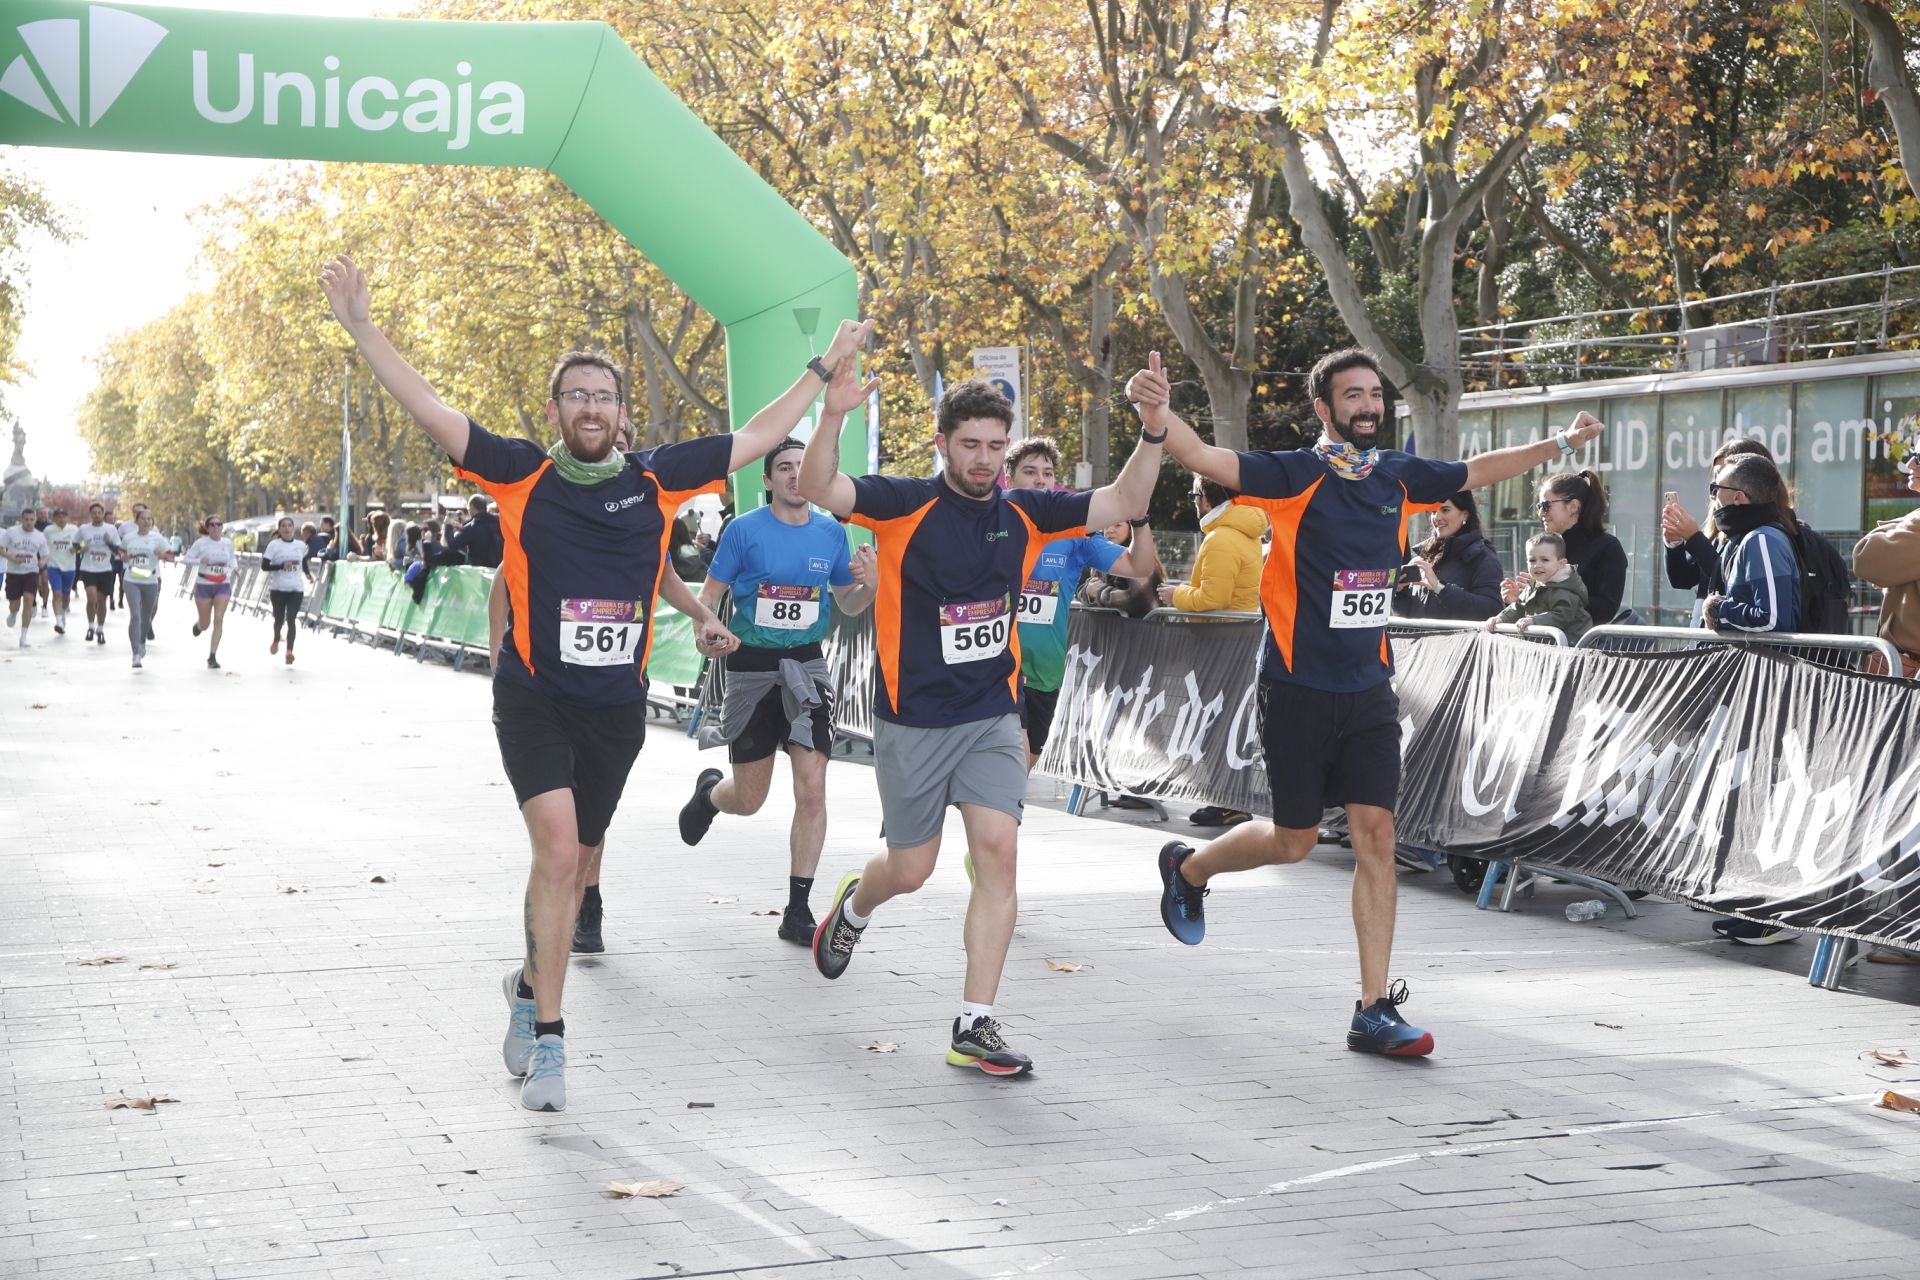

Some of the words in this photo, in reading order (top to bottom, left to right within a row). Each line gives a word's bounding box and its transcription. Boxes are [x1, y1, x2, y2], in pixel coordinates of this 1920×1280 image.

[193, 50, 526, 150] Unicaja
[773, 602, 801, 621] 88
[1018, 595, 1042, 615] 90
[1342, 592, 1386, 617] 562
[574, 626, 629, 652] 561
[954, 620, 1005, 650] 560
[1166, 669, 1224, 765] de
[1755, 729, 1852, 886] de
